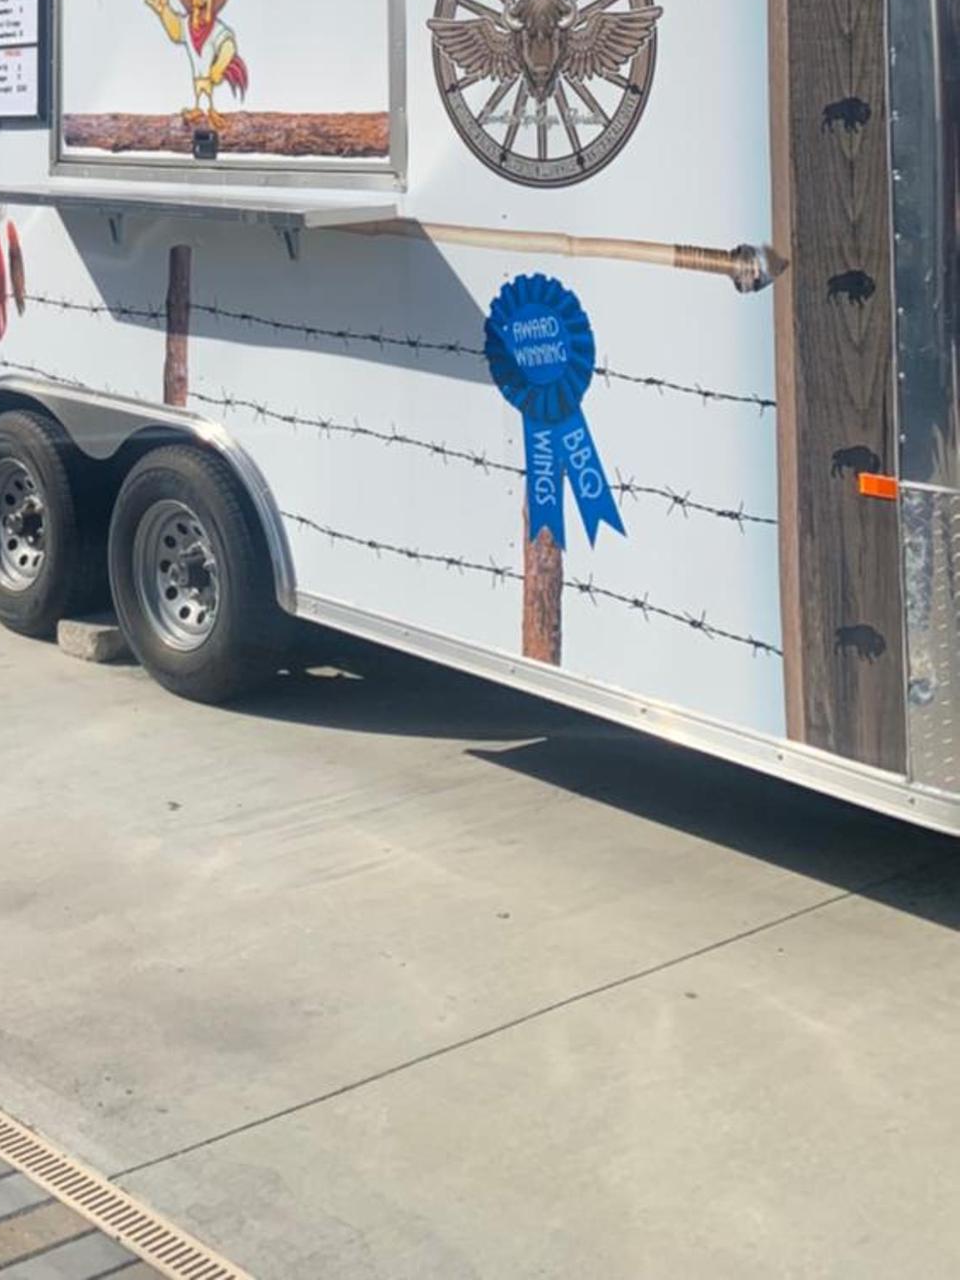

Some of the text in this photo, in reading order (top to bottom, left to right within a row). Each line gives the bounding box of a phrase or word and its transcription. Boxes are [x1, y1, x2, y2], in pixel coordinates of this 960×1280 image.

[512, 315, 560, 342] AWARD
[513, 341, 568, 368] WINNING
[532, 428, 557, 507] WINGS
[562, 426, 603, 500] BBQ
